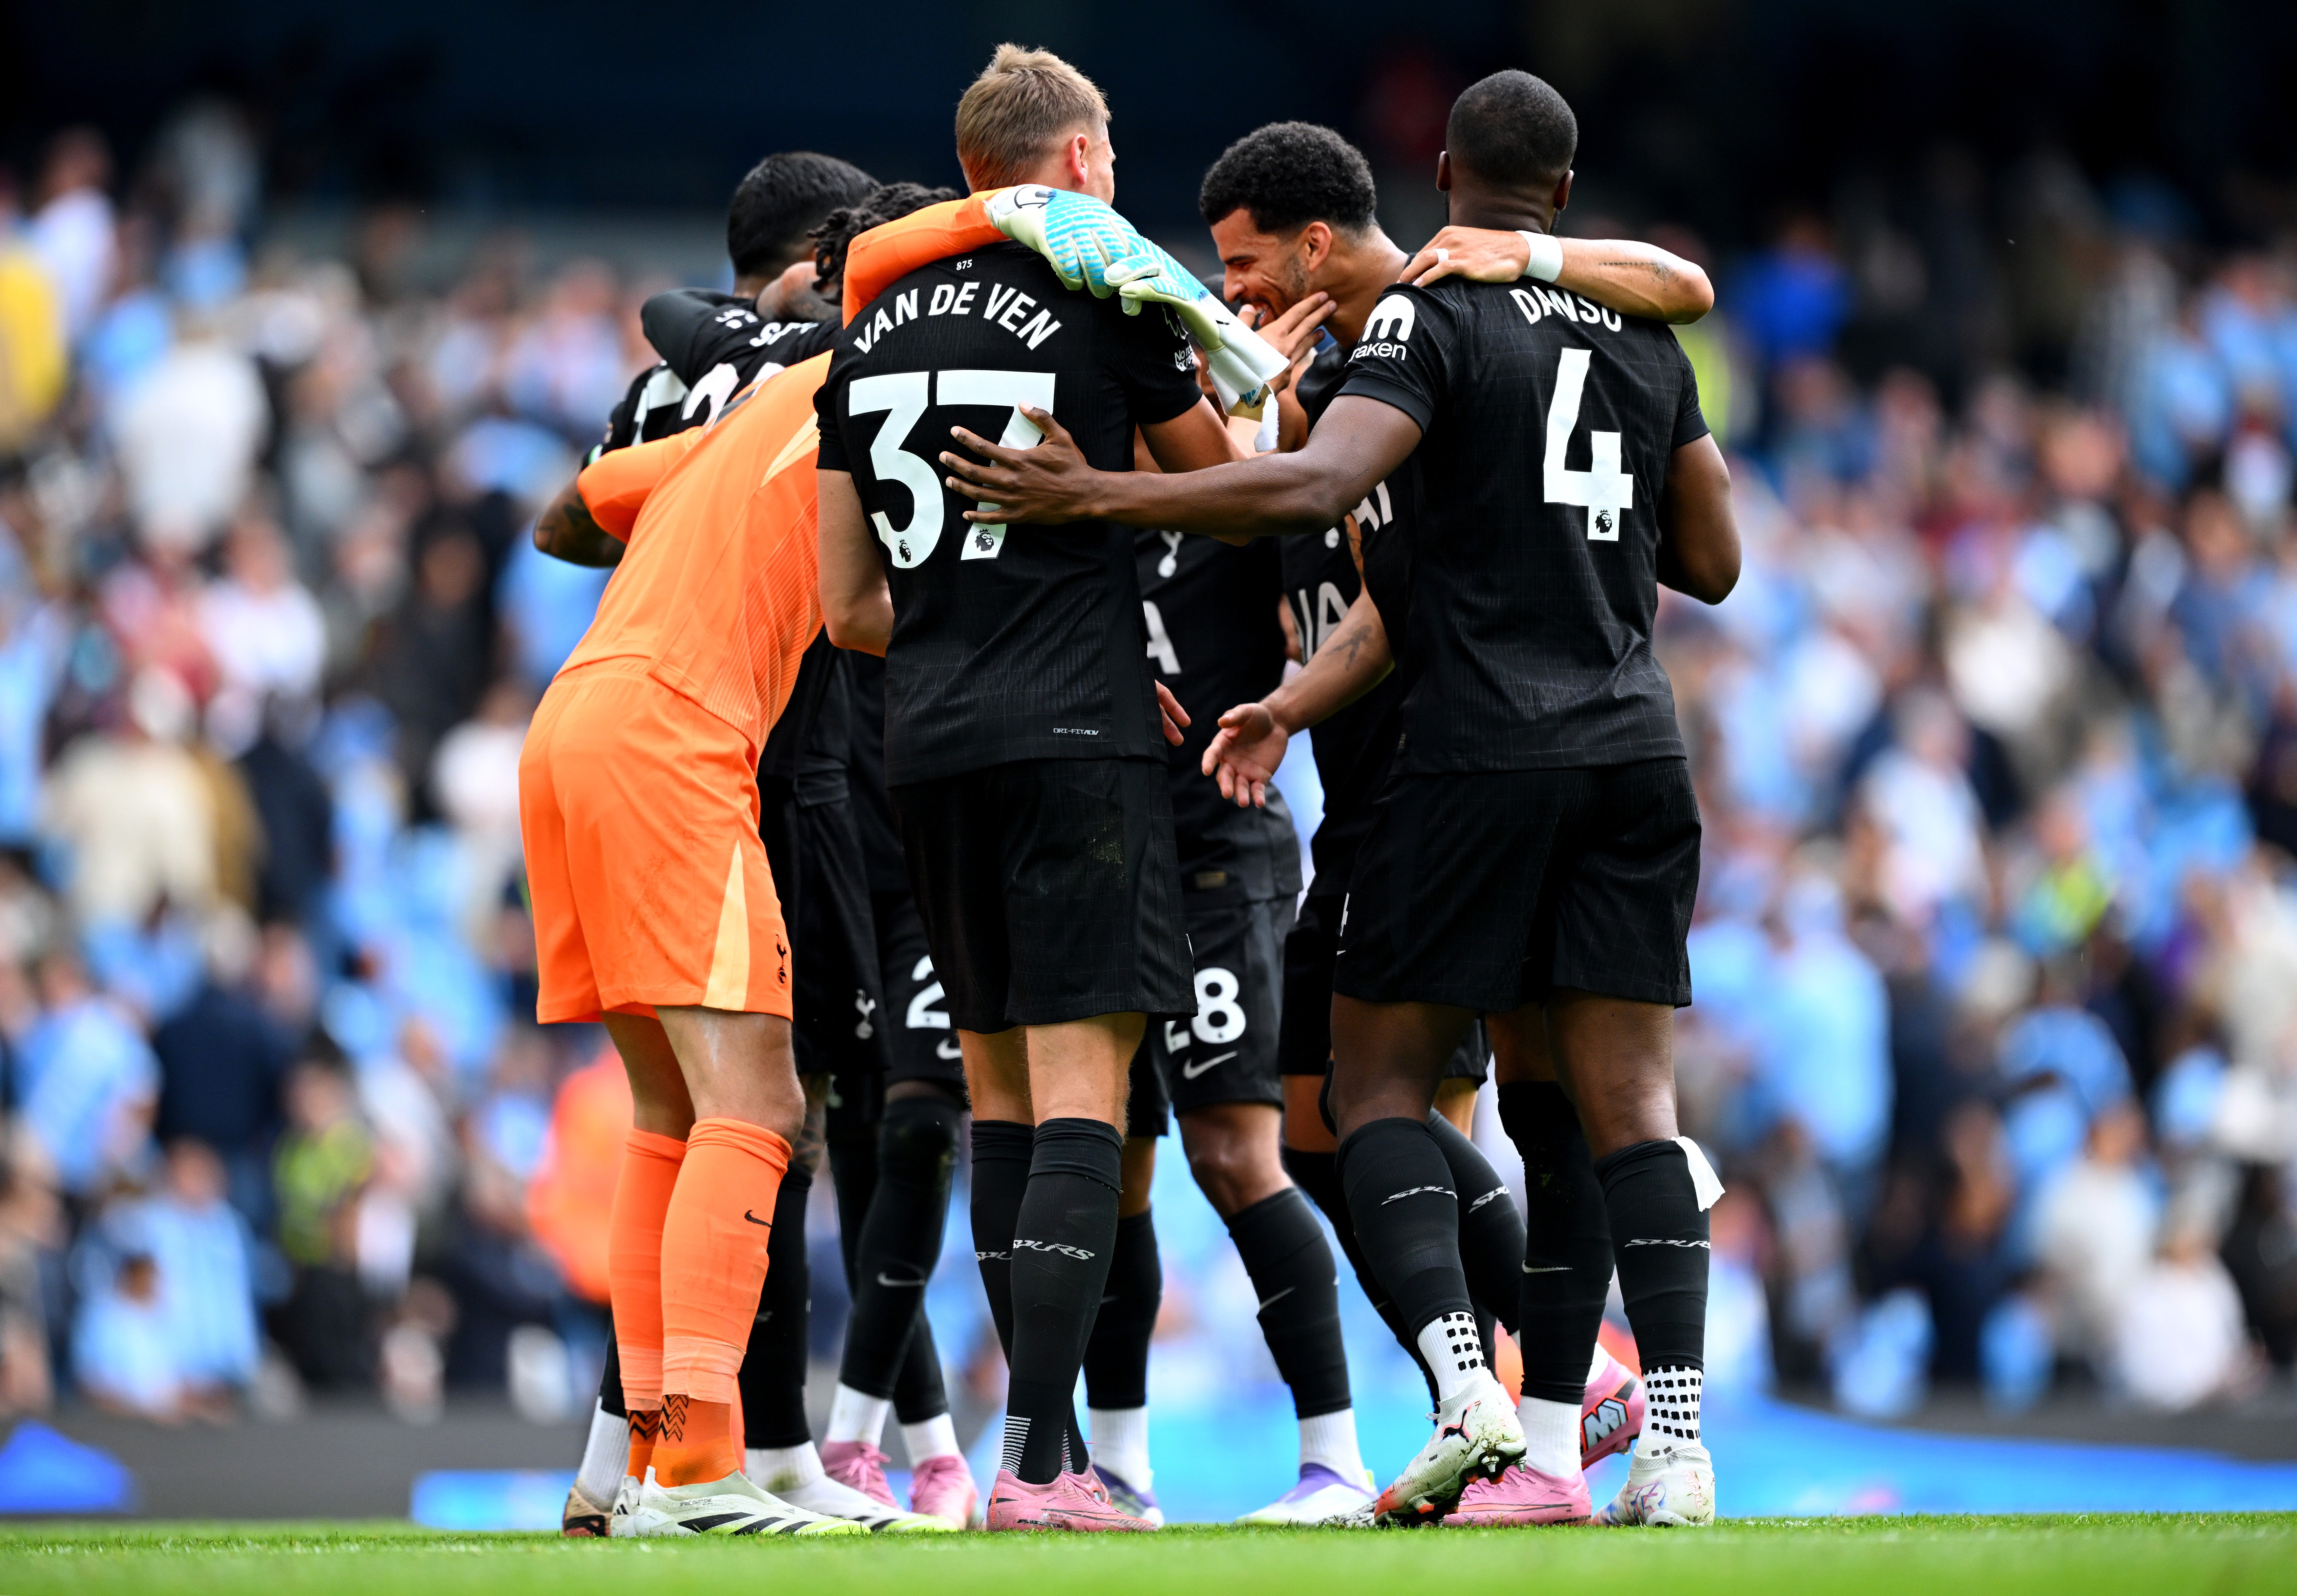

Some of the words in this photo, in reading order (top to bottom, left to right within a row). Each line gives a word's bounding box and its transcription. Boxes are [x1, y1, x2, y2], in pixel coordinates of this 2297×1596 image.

[956, 259, 972, 270] 875
[853, 288, 918, 354] VAN
[928, 281, 981, 316] DE
[983, 282, 1063, 351] VEN
[1344, 342, 1406, 367] raken
[848, 370, 1056, 570] 37
[1543, 347, 1633, 542] 4
